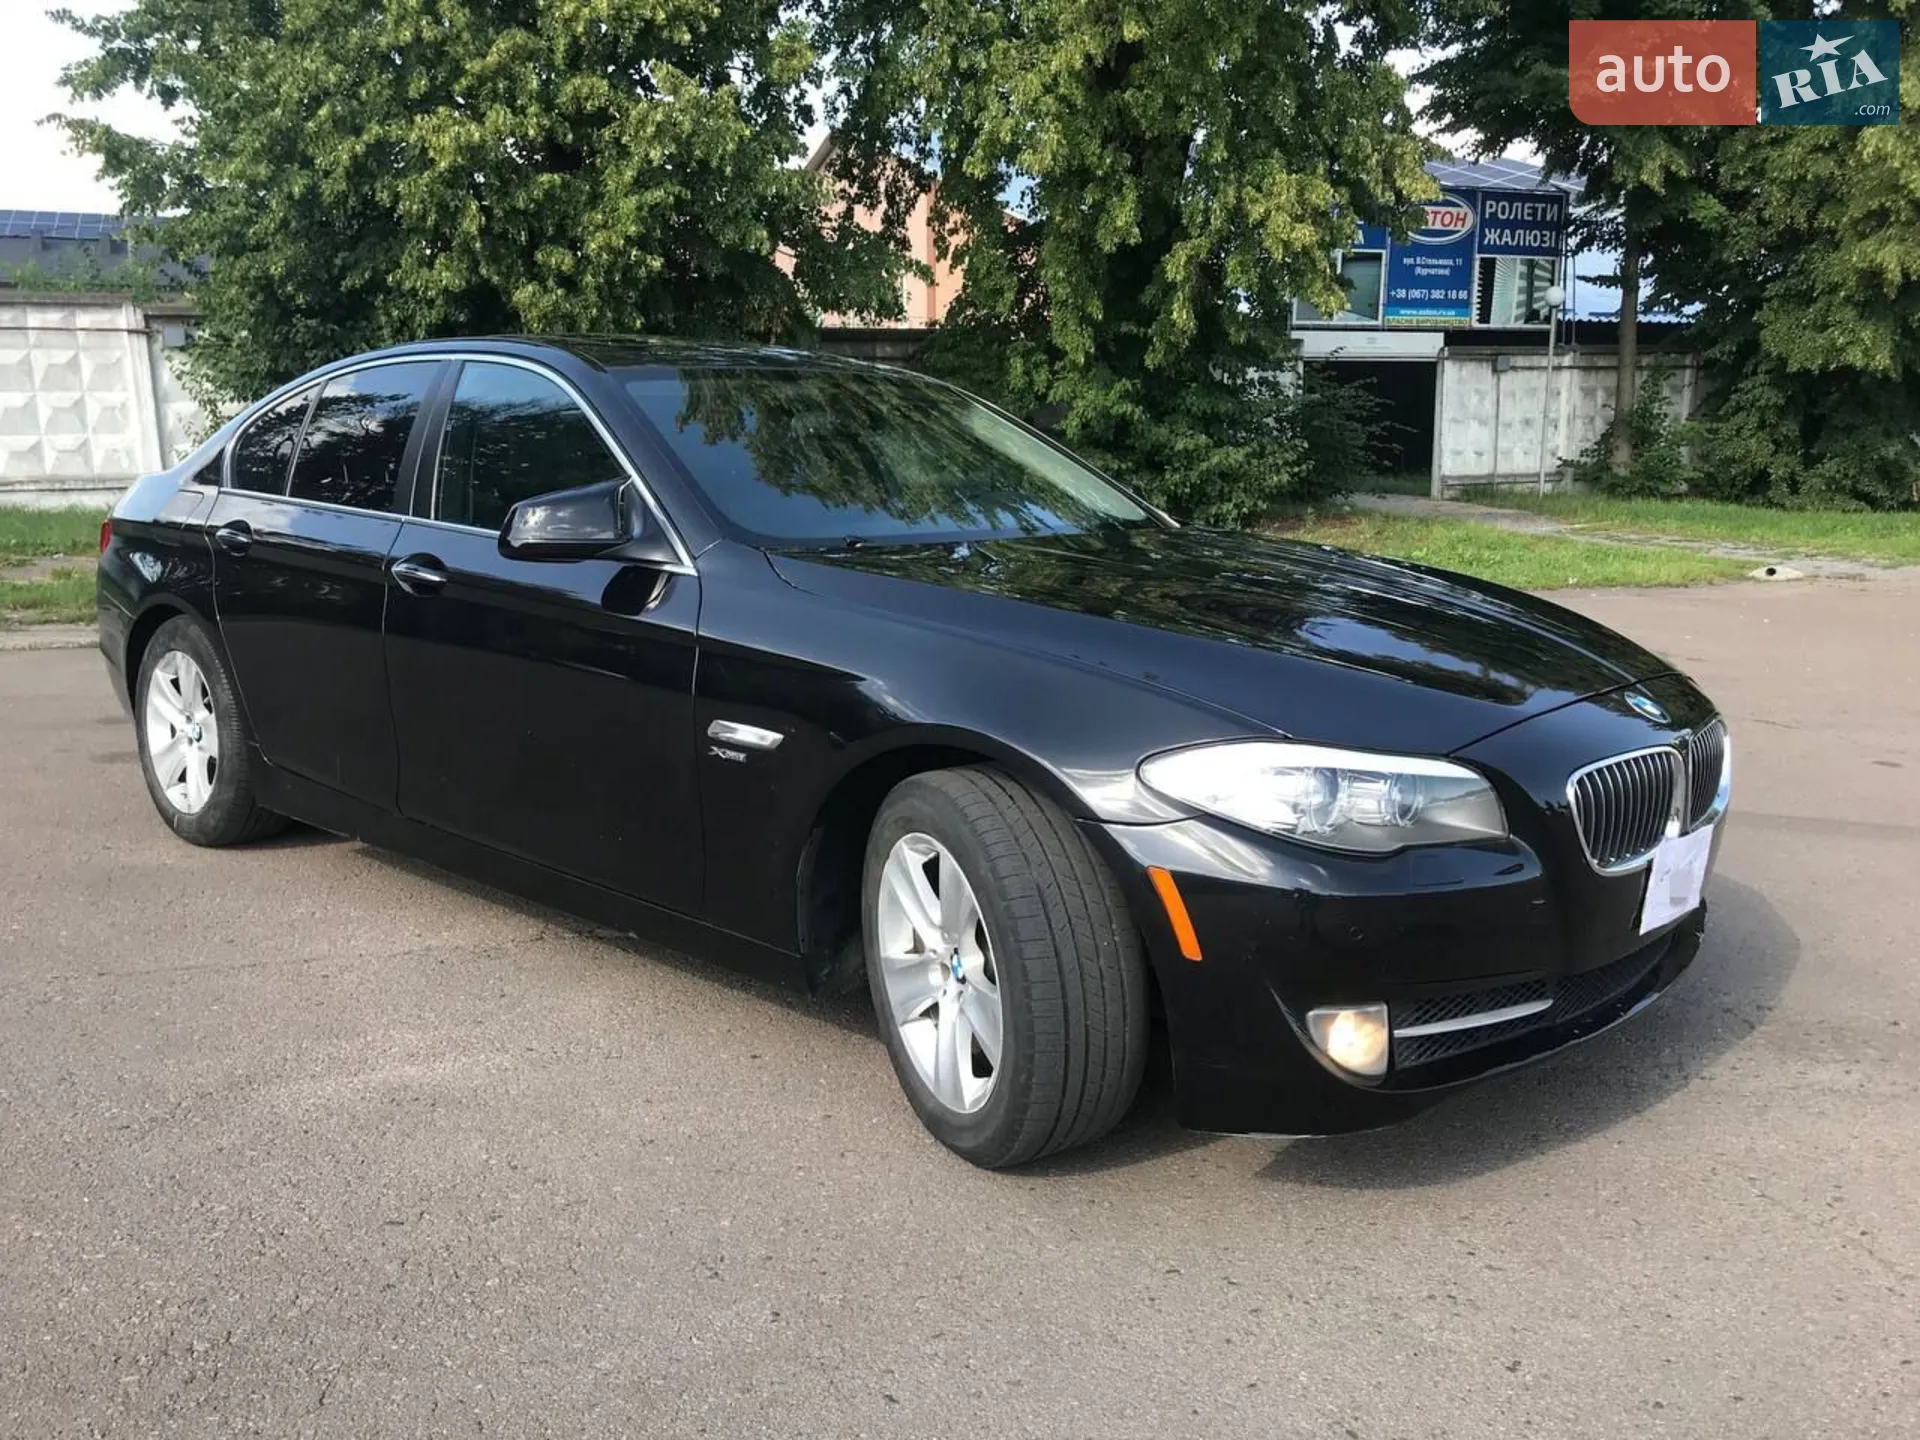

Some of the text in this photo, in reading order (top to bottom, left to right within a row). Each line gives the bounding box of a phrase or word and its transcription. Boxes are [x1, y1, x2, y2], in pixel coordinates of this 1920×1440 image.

[1485, 200, 1558, 221] РОЛЕТИ
[1484, 228, 1556, 248] ЖАЛЮЗІ
[1389, 289, 1407, 299] +38
[1408, 289, 1429, 300] (067)
[1447, 290, 1457, 300] 18
